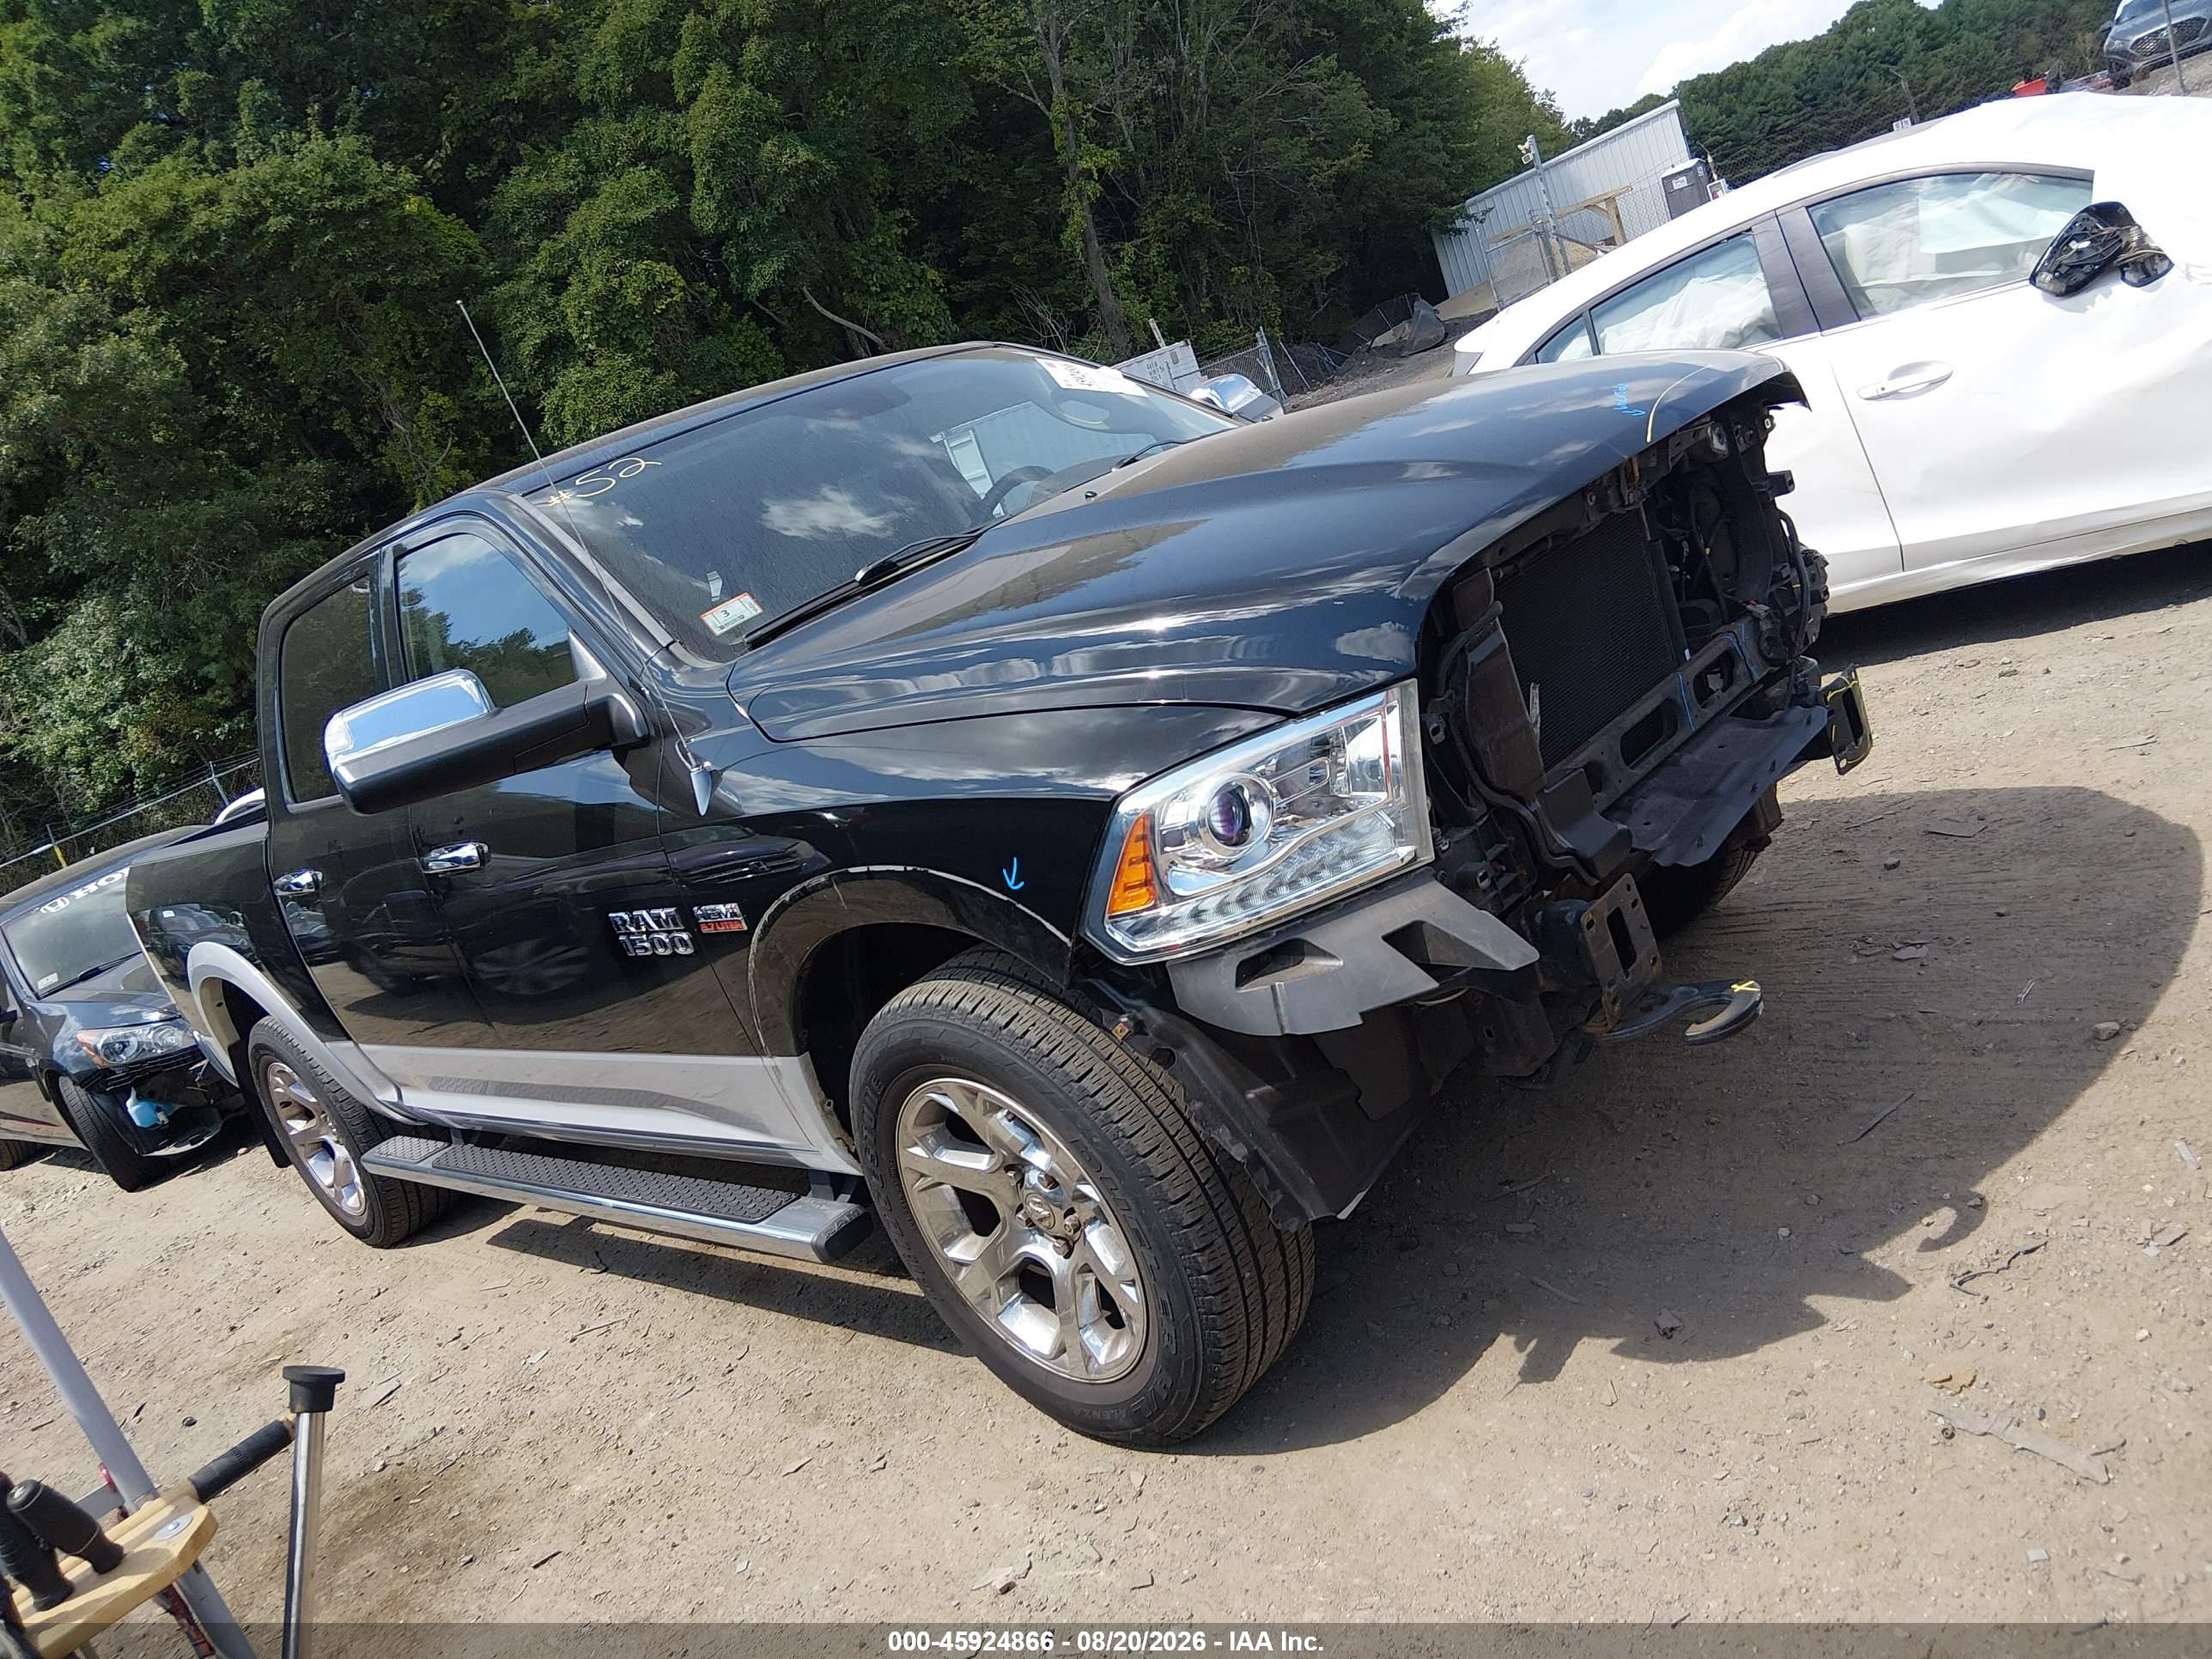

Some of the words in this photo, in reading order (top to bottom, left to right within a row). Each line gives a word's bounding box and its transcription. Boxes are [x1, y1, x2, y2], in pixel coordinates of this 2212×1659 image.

[720, 610, 730, 618] 3
[608, 907, 685, 934] RAM
[692, 902, 743, 922] HEMI
[701, 922, 714, 932] 5.7
[716, 921, 743, 930] LITER
[618, 930, 696, 957] 1500
